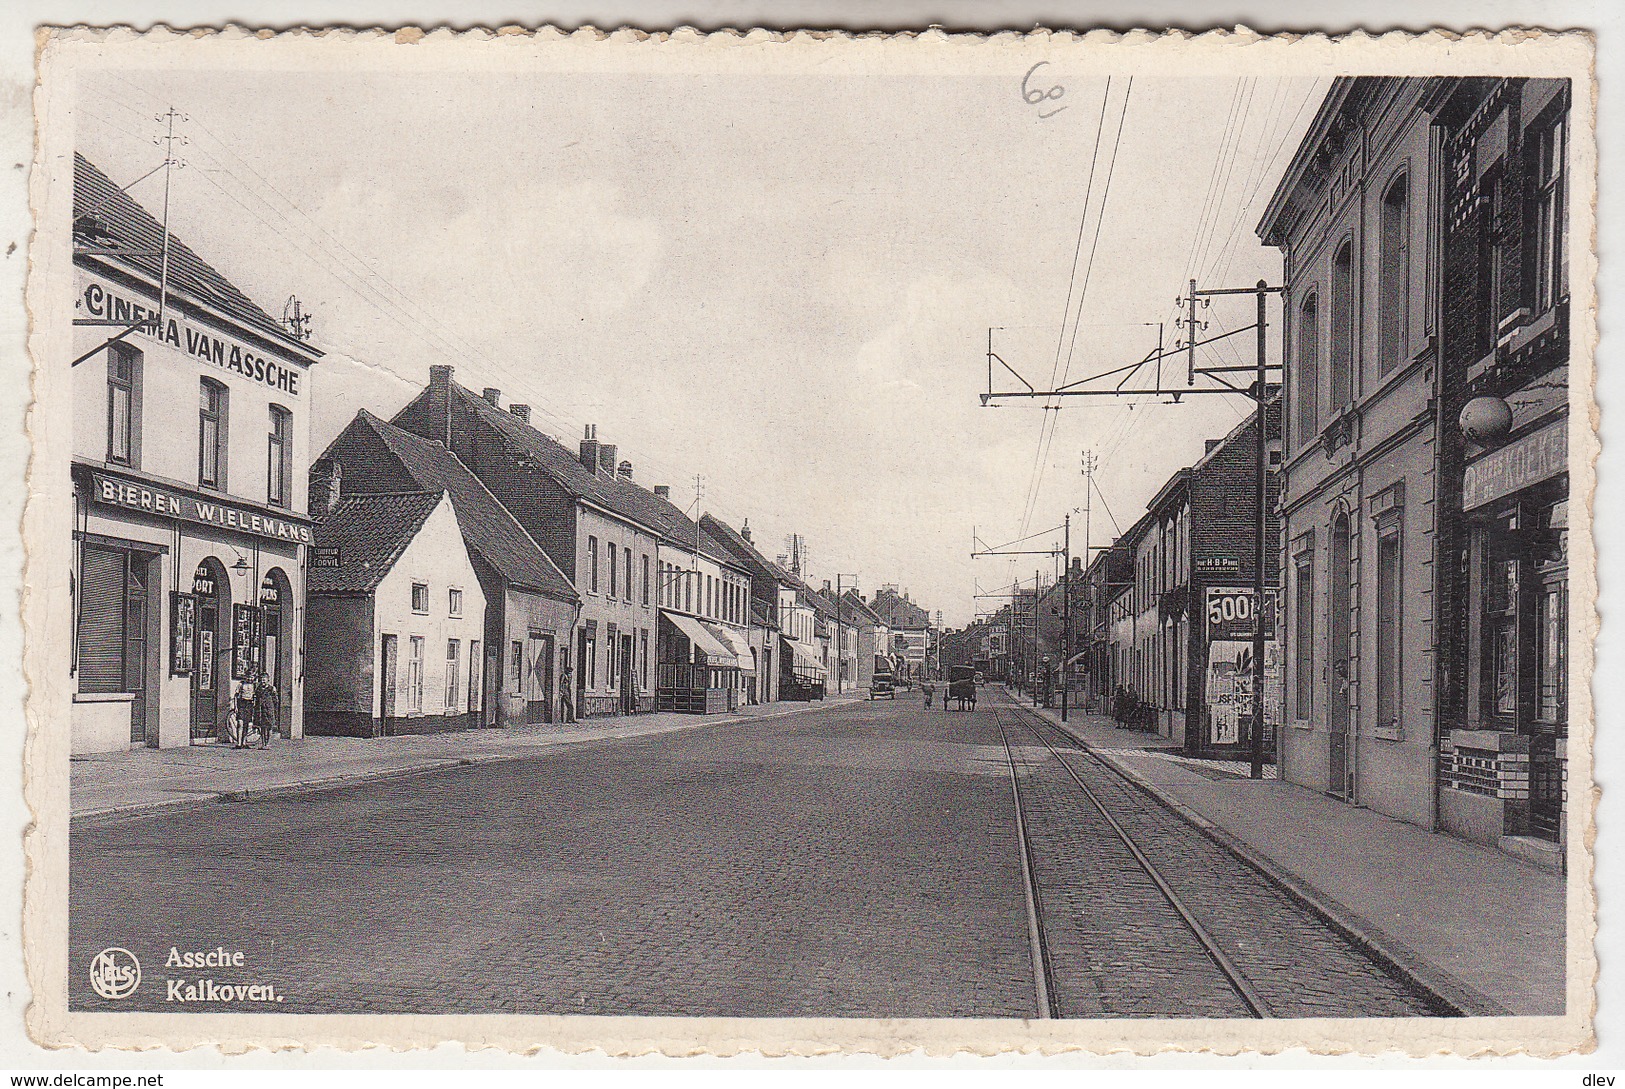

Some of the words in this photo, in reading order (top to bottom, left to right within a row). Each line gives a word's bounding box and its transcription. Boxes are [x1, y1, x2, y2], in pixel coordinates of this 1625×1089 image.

[1021, 61, 1064, 104] 60
[84, 283, 180, 348] CINEMA
[186, 327, 224, 367] VAN
[227, 343, 299, 395] ASSCHE
[102, 480, 180, 515] BIEREN
[195, 502, 310, 542] WIELEMANS
[165, 946, 245, 968] Assche
[165, 979, 284, 1002] Kalkoven.
